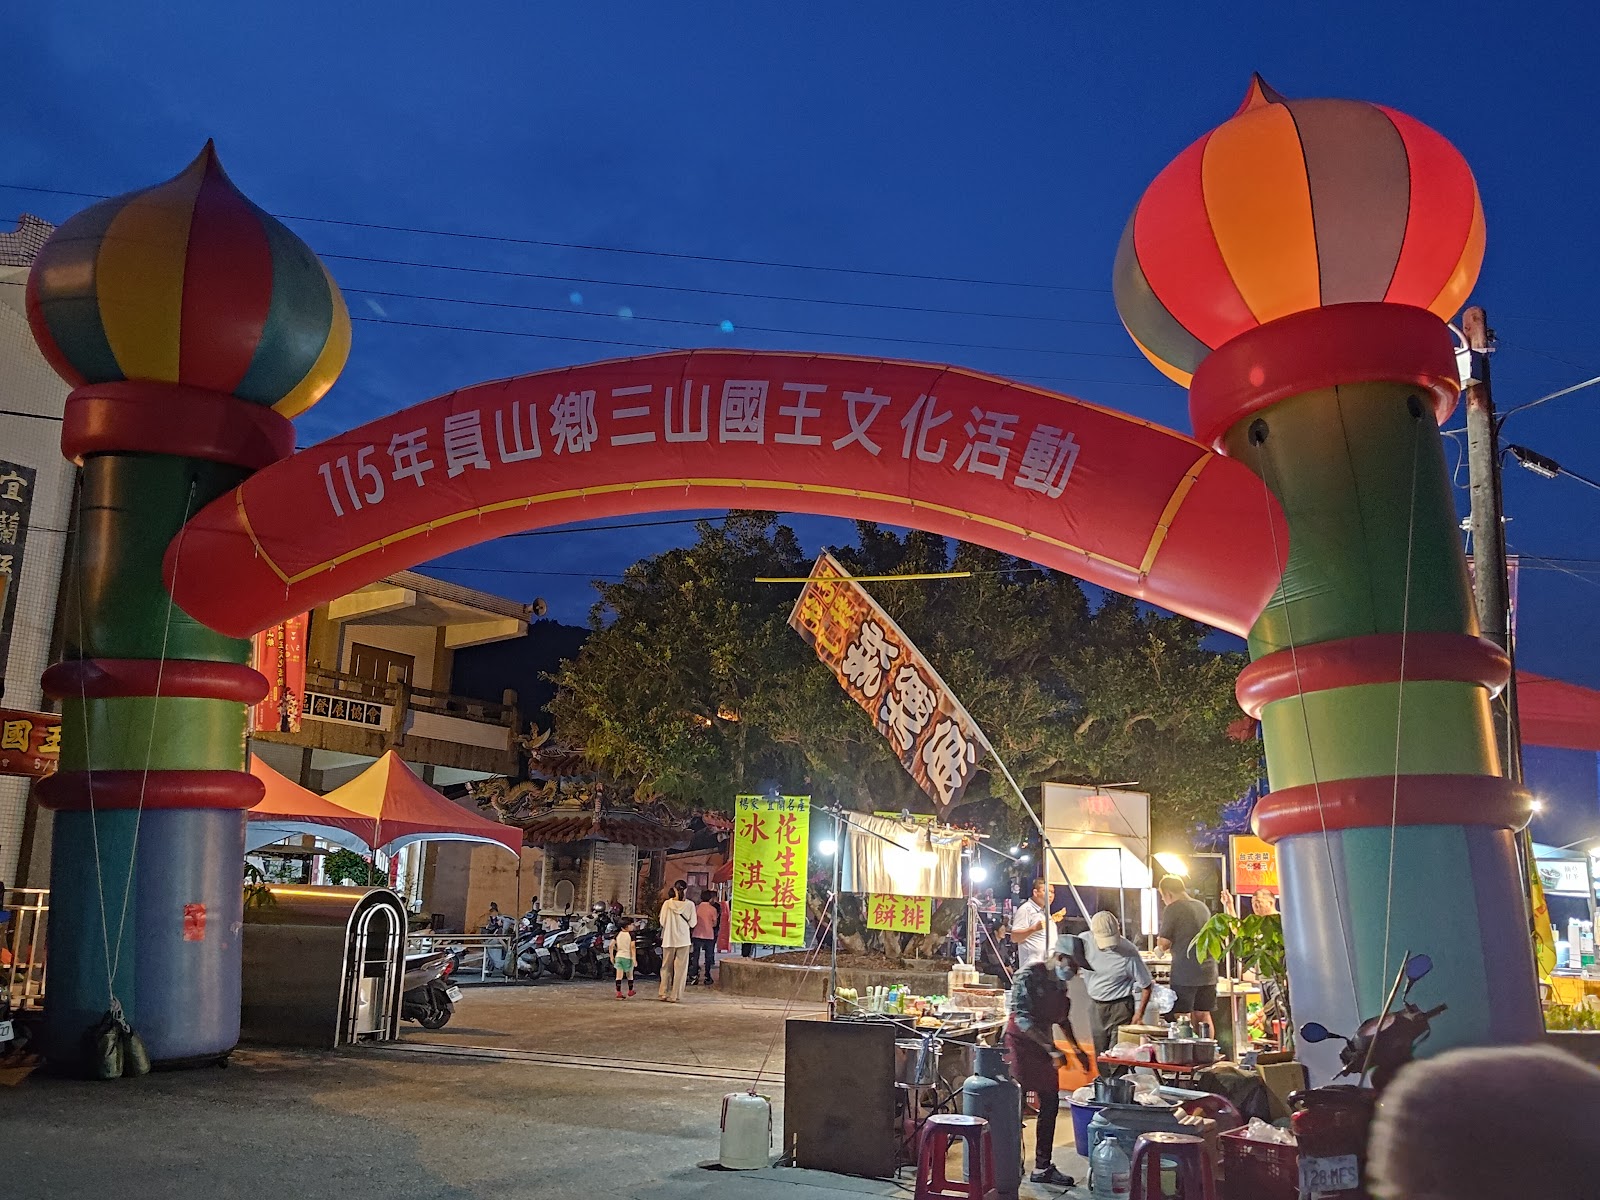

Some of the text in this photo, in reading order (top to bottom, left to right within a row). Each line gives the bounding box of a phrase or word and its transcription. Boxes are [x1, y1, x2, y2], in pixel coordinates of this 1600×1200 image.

[318, 380, 1081, 516] 115年員山鄉三山國王文化活動
[735, 812, 769, 940] 冰淇淋
